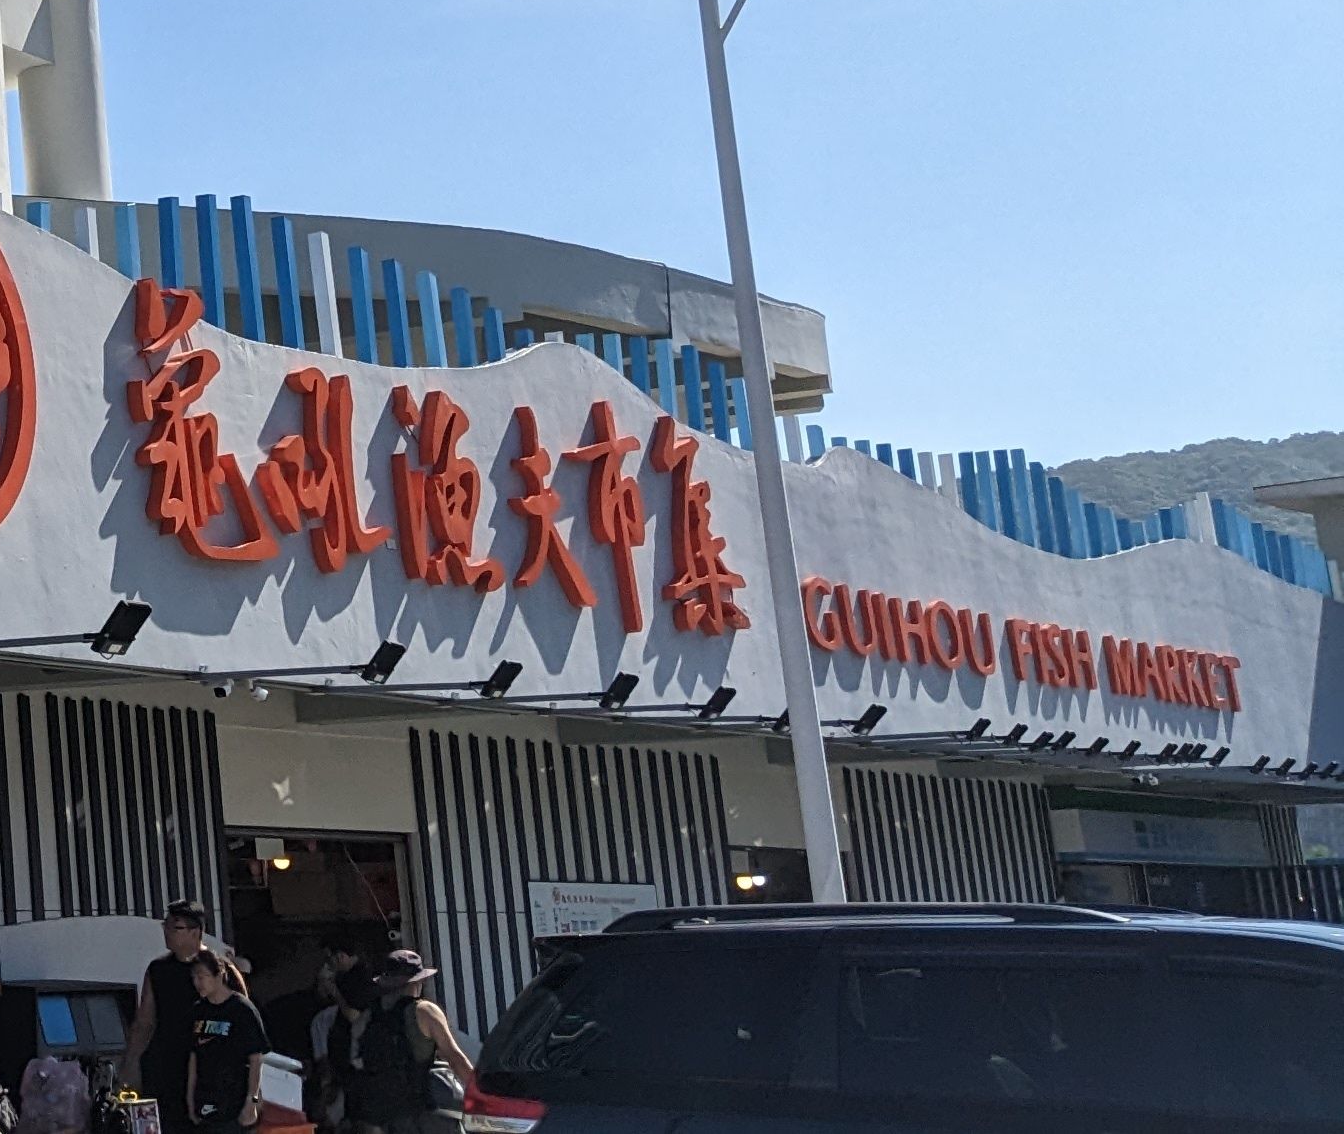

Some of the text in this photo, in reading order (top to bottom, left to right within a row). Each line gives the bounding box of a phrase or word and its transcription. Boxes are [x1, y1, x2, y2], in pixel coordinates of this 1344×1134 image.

[802, 576, 1243, 713] GUIHOU FISH MARKET
